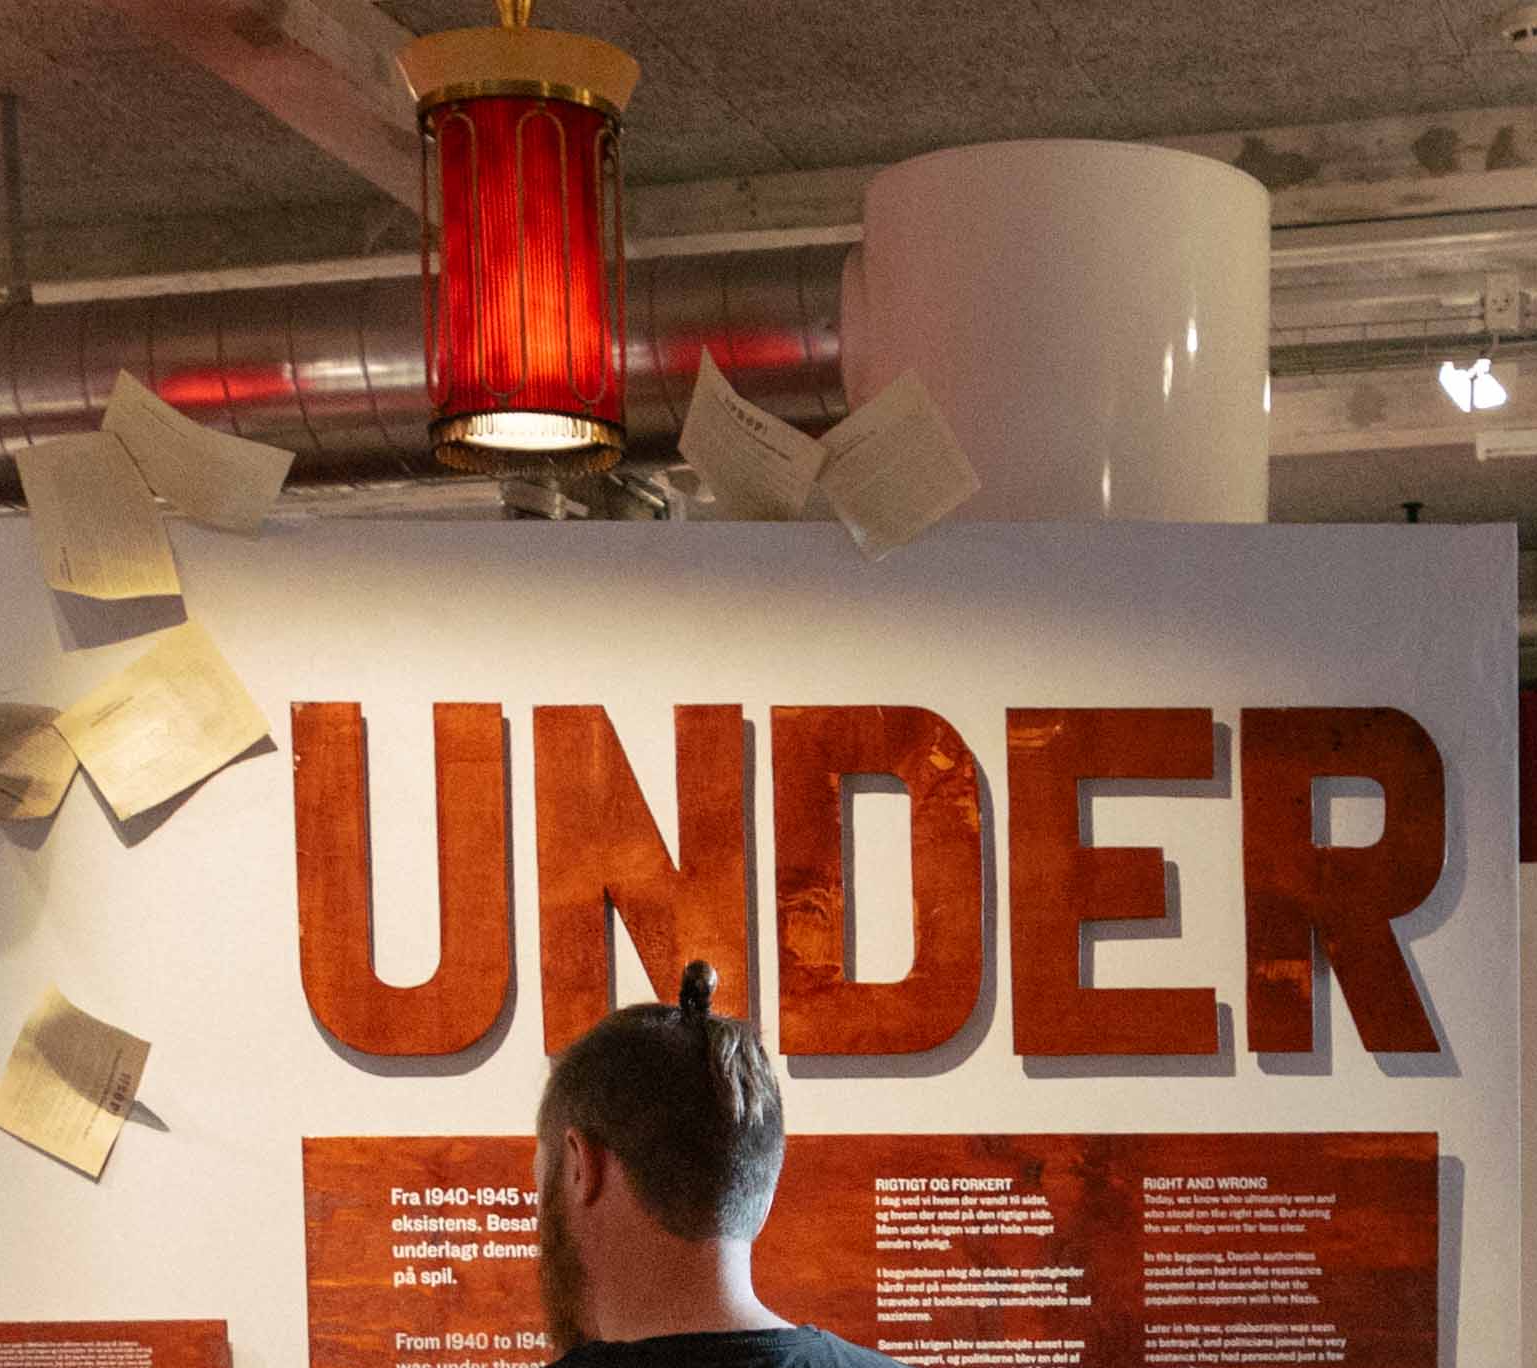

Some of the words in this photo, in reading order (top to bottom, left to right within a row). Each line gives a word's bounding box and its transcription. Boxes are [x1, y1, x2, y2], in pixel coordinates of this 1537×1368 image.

[291, 701, 1447, 1058] UNDER
[876, 1178, 928, 1192] RIGTIGT
[930, 1178, 950, 1192] OG
[952, 1178, 1014, 1192] FORKERT
[1143, 1177, 1183, 1191] RIGHT
[1187, 1177, 1215, 1190] AND
[1218, 1176, 1269, 1190] WRONG
[391, 1188, 421, 1205] Fra
[425, 1187, 520, 1205] 1940-1945
[392, 1215, 482, 1232] eksistens.
[392, 1241, 478, 1261] underlagt
[393, 1266, 417, 1287] på
[420, 1268, 458, 1286] spil.
[395, 1332, 441, 1350] From
[445, 1332, 489, 1350] 1940
[493, 1334, 512, 1349] to
